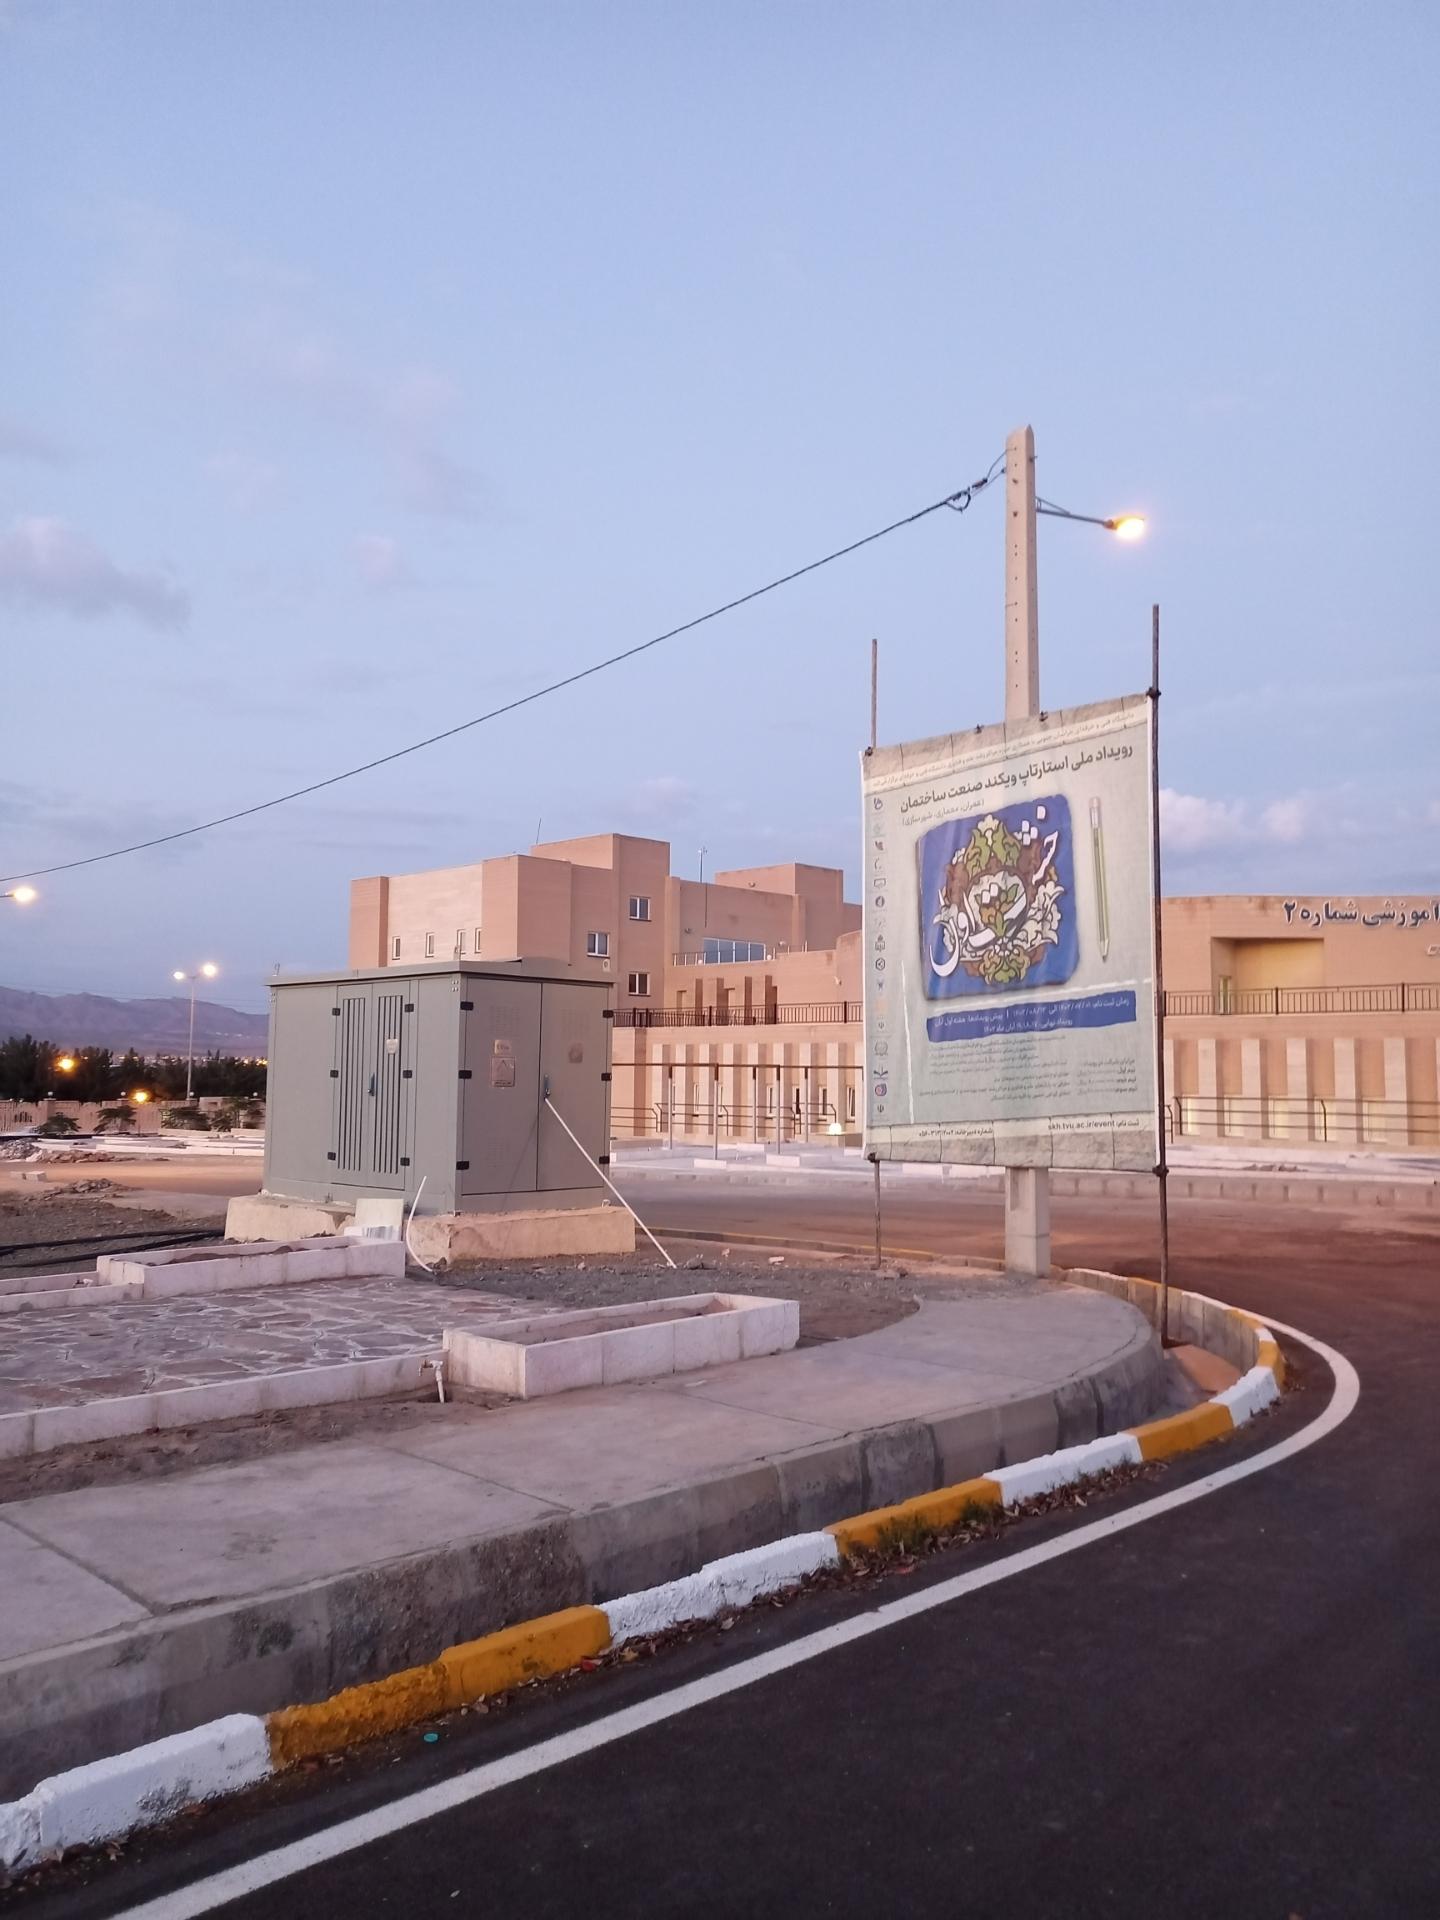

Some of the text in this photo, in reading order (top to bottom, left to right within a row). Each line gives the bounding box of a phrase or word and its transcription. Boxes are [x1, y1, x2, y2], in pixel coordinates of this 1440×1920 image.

[900, 745, 1133, 813] رویداد ملی استارتاپ ویکند صنعت ساختمان
[1284, 901, 1296, 924] ۲
[1300, 901, 1358, 927] شماره
